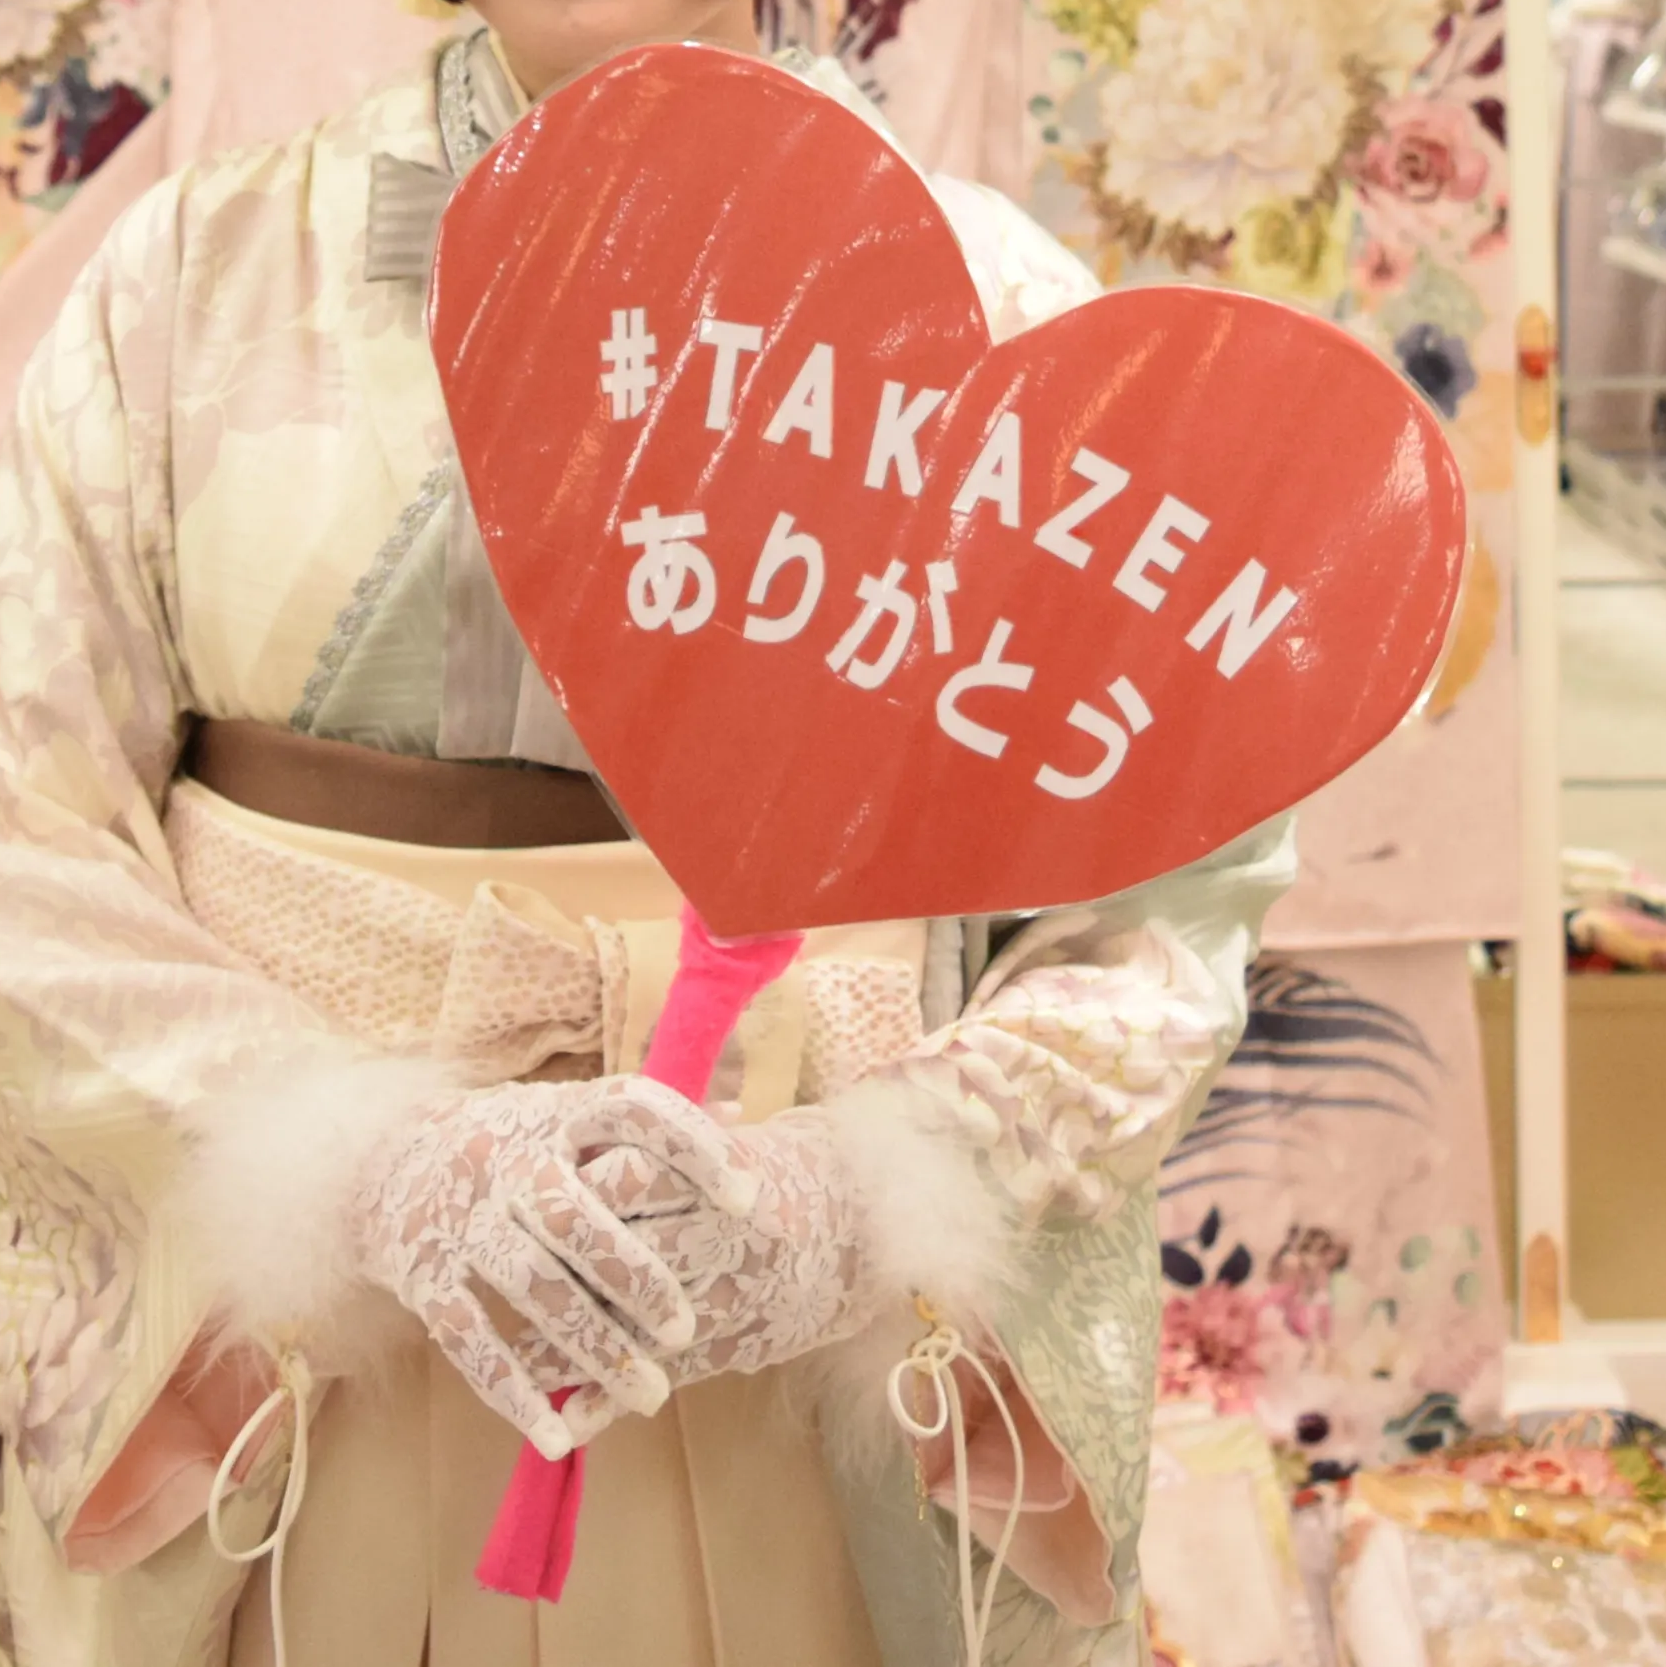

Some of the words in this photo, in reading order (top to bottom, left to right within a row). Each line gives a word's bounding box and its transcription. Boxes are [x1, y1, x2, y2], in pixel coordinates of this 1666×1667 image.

[601, 308, 1297, 678] #TAKAZEN
[621, 506, 1153, 800] ありがとう
